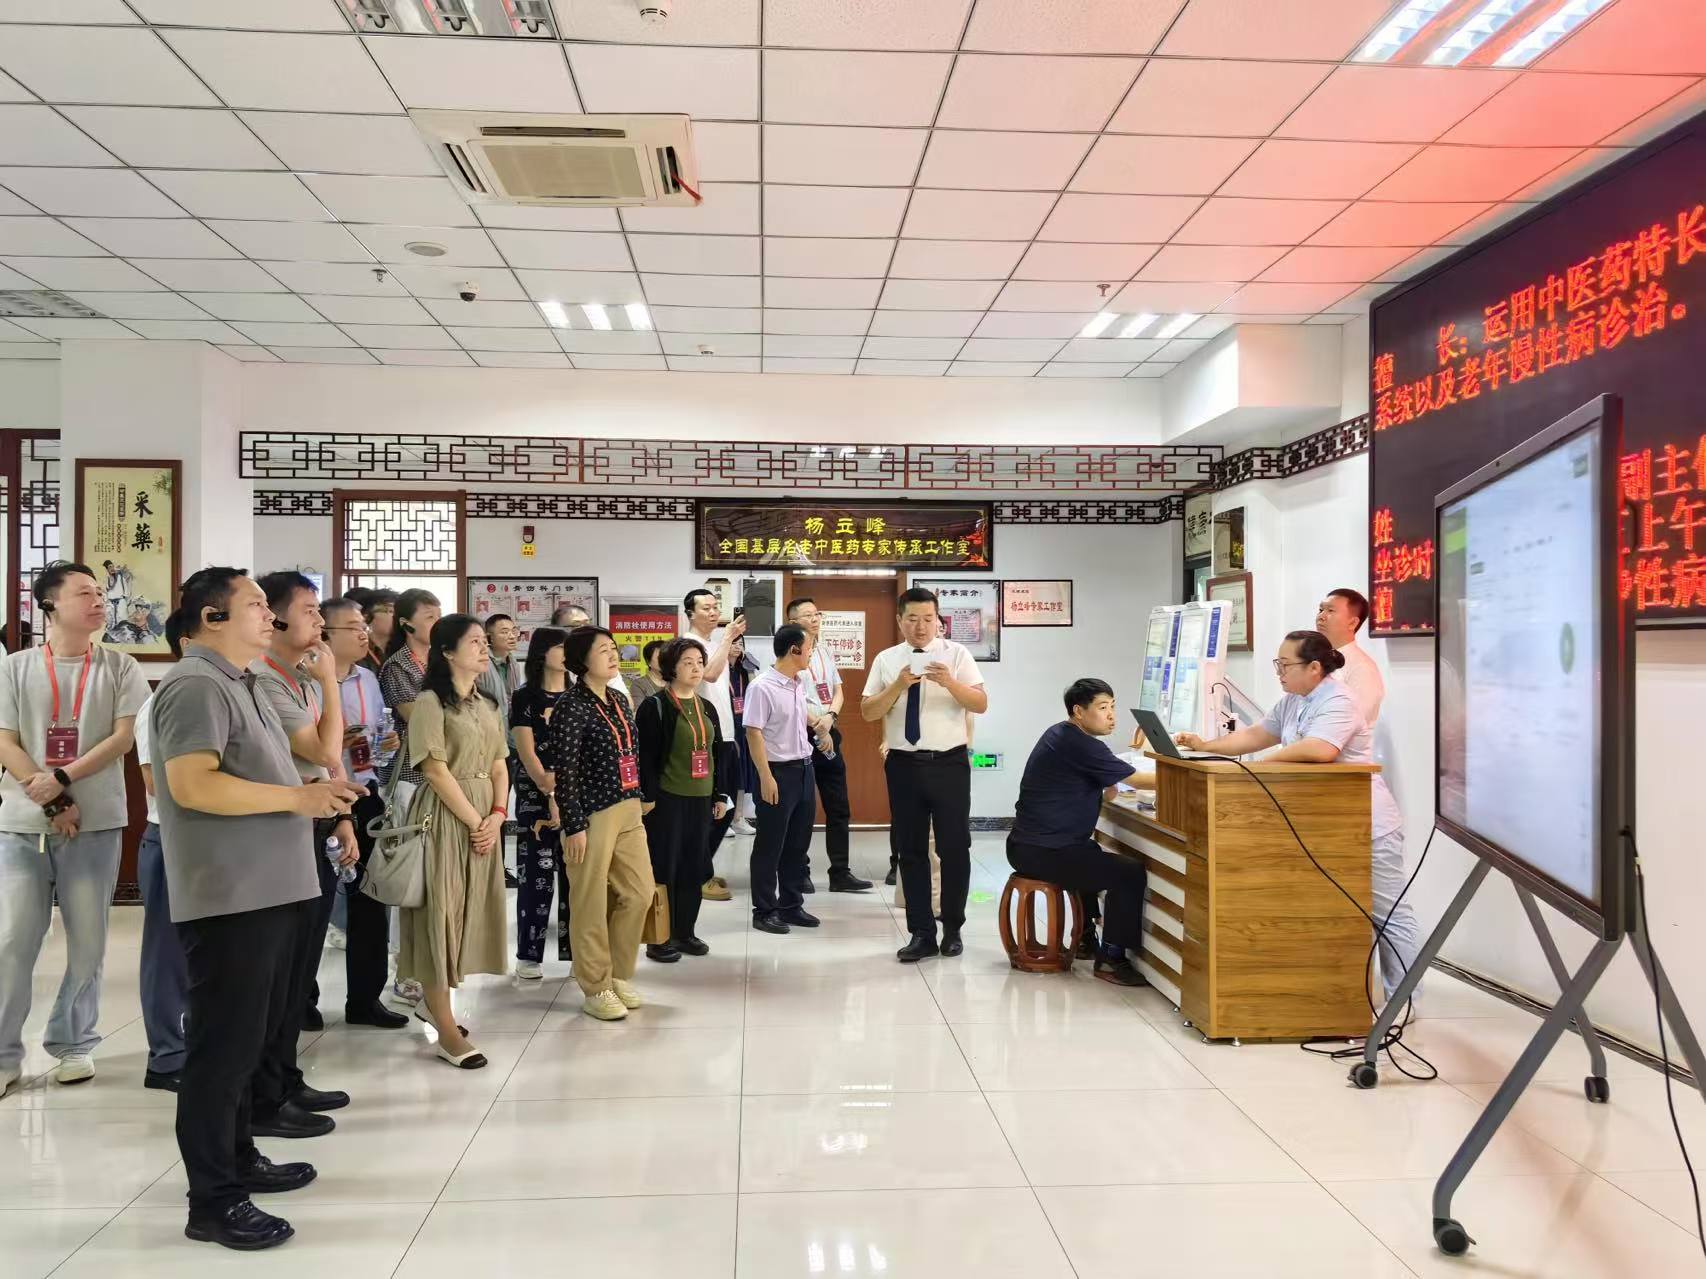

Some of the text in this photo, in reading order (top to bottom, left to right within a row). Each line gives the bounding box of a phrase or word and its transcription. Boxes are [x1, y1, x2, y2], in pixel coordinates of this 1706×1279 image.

[1374, 281, 1687, 430] 系统以及老年慢性病诊治。
[805, 517, 886, 535] 杨立峰
[718, 539, 971, 557] 全国基层名老中医药专家传承工作室
[615, 621, 672, 631] 消防栓使用方法
